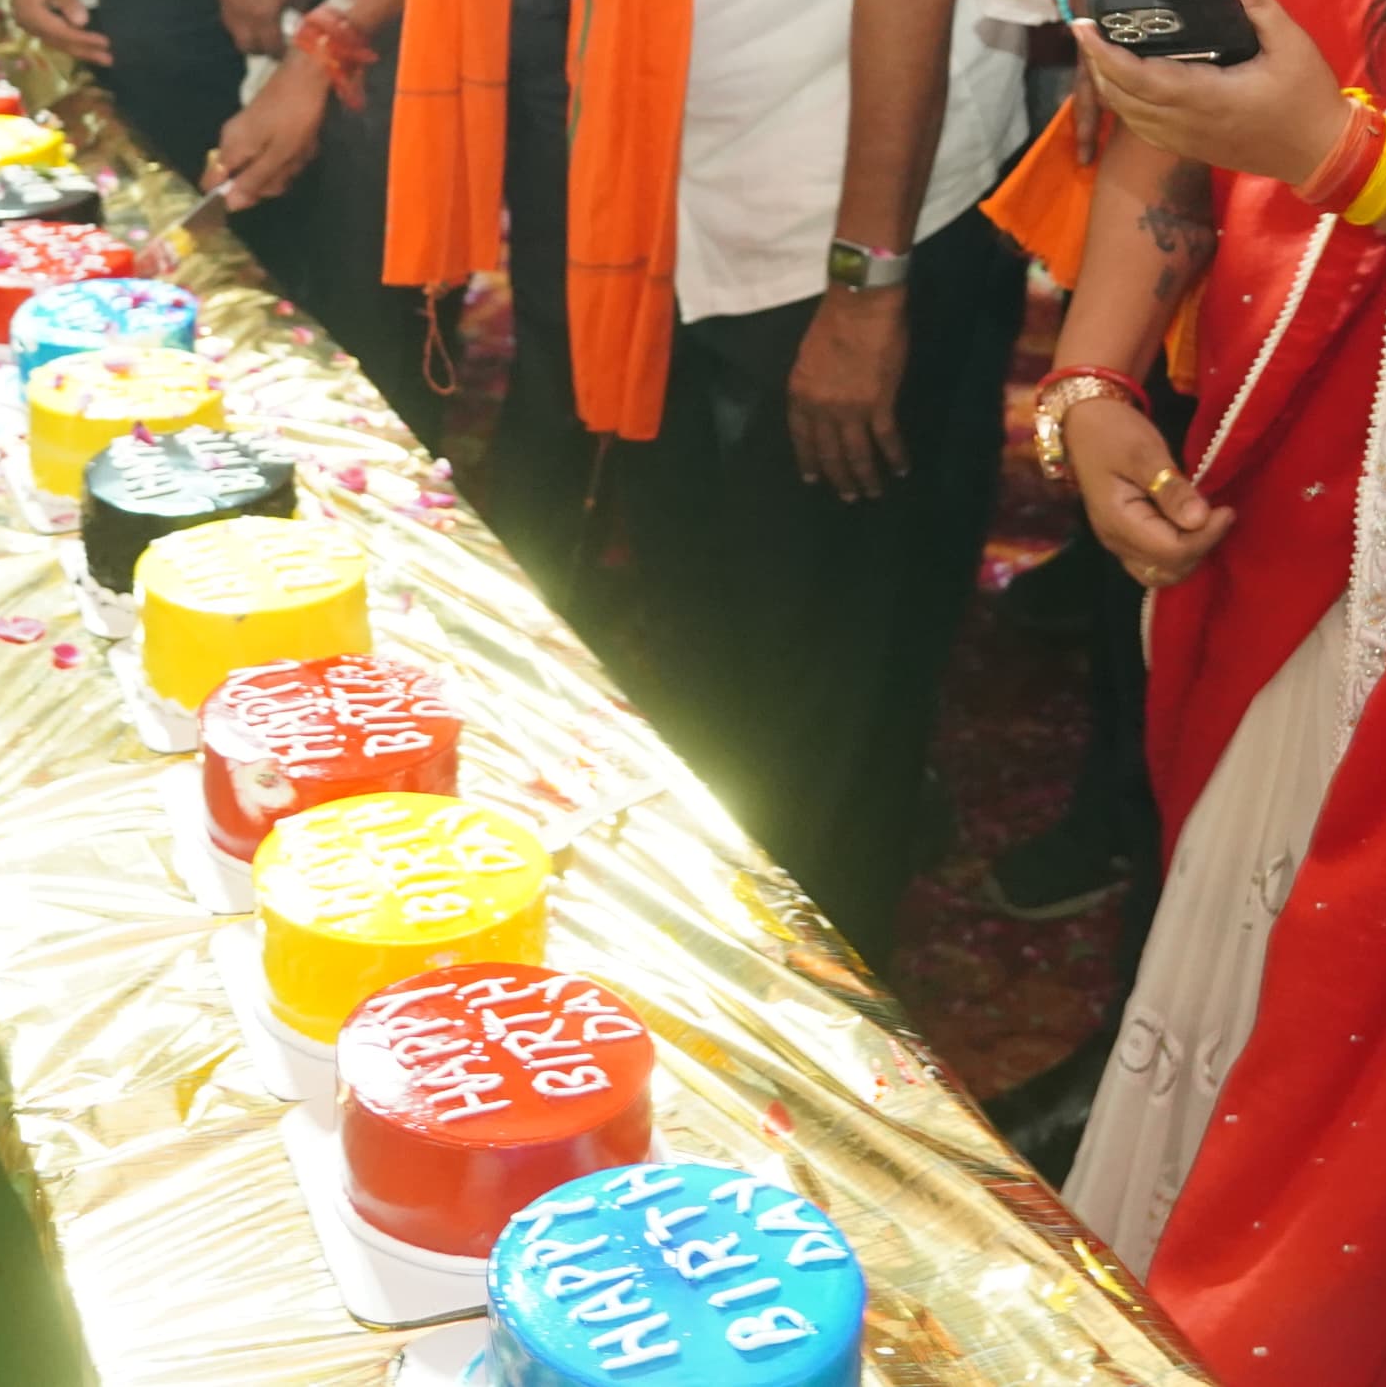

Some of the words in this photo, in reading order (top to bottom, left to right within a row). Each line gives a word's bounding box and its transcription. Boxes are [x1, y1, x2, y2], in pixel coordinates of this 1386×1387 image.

[349, 800, 470, 925] BIRTH
[365, 983, 511, 1122] HAPPY
[454, 976, 611, 1097] BIRTH
[530, 974, 644, 1041] DAY
[511, 1195, 680, 1370] HAPPY
[603, 1163, 819, 1352] BIRTH
[709, 1175, 849, 1267] DAY
